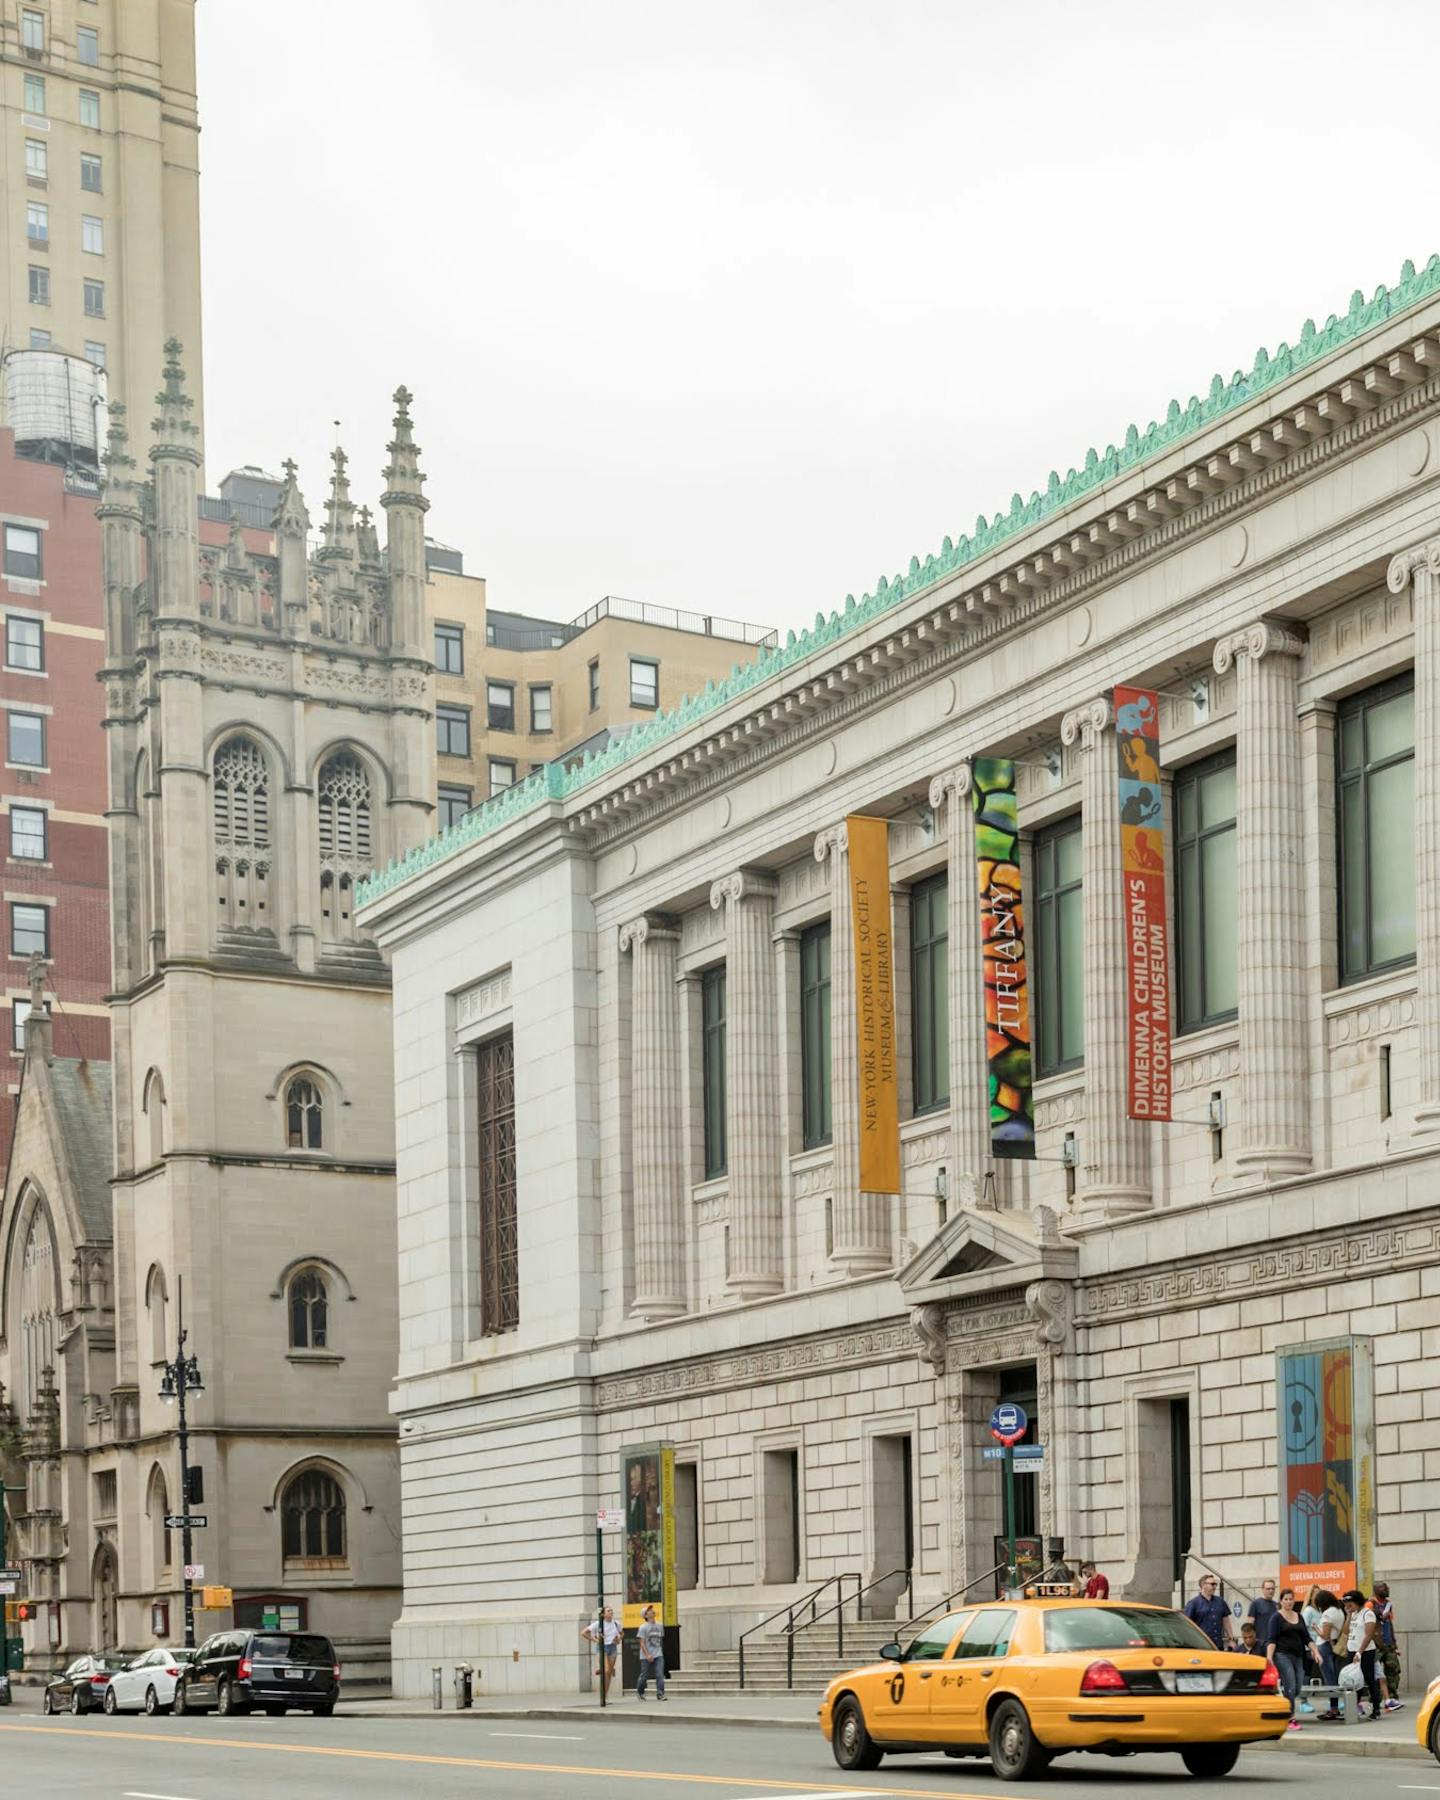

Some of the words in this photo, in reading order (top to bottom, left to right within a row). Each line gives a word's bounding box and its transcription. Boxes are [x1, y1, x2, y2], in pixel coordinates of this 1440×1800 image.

[856, 877, 870, 943] SOCIETY
[1130, 879, 1149, 1005] CHILDREN'S
[859, 949, 876, 1043] HISTORICAL
[876, 930, 891, 995] LIBRARY
[990, 883, 1021, 1035] TIFFANY
[1149, 924, 1167, 1021] MUSEUM
[862, 1049, 877, 1132] NEW-YORK
[879, 1015, 894, 1083] MUSEUM
[1134, 1010, 1150, 1115] DIMENNA
[1152, 1027, 1168, 1117] HISTORY
[983, 1448, 1002, 1458] M10
[1039, 1586, 1069, 1596] 1L96
